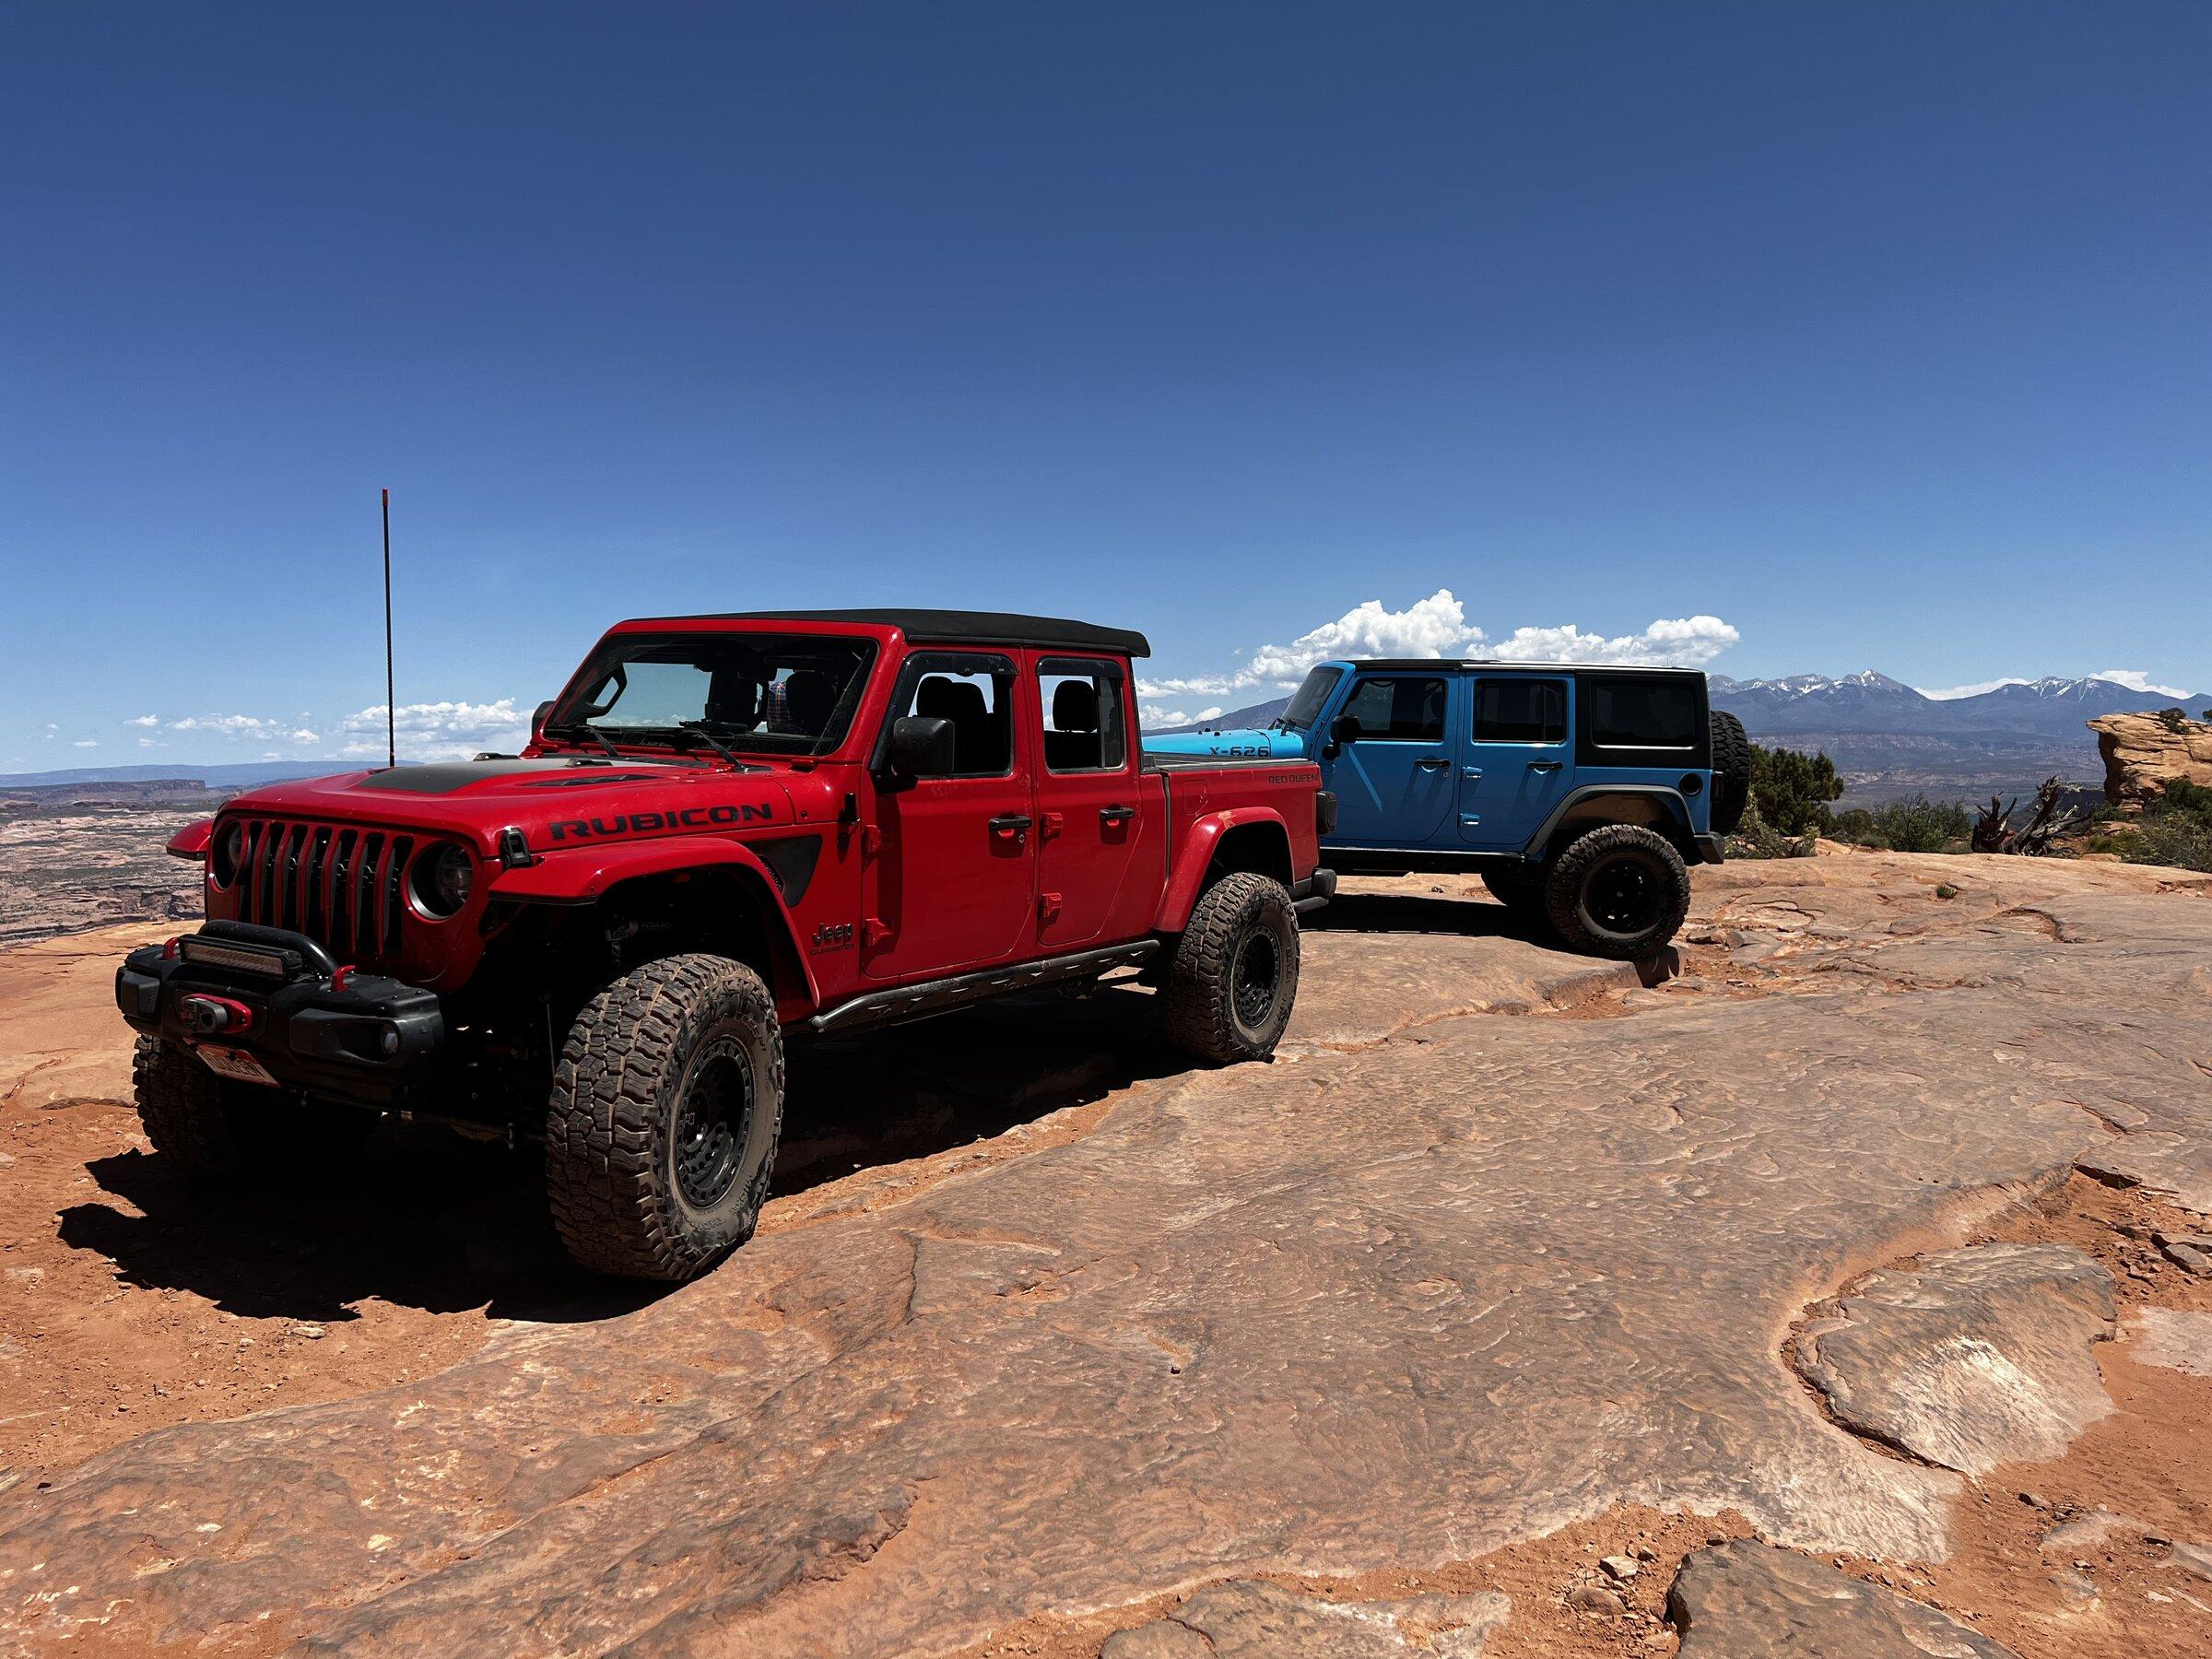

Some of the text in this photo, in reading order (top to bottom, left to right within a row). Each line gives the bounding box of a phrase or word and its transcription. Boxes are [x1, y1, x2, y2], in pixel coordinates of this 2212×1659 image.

[1268, 774, 1319, 784] RED QUEEN
[547, 803, 772, 841] RUBICON
[811, 923, 853, 947] Jeep
